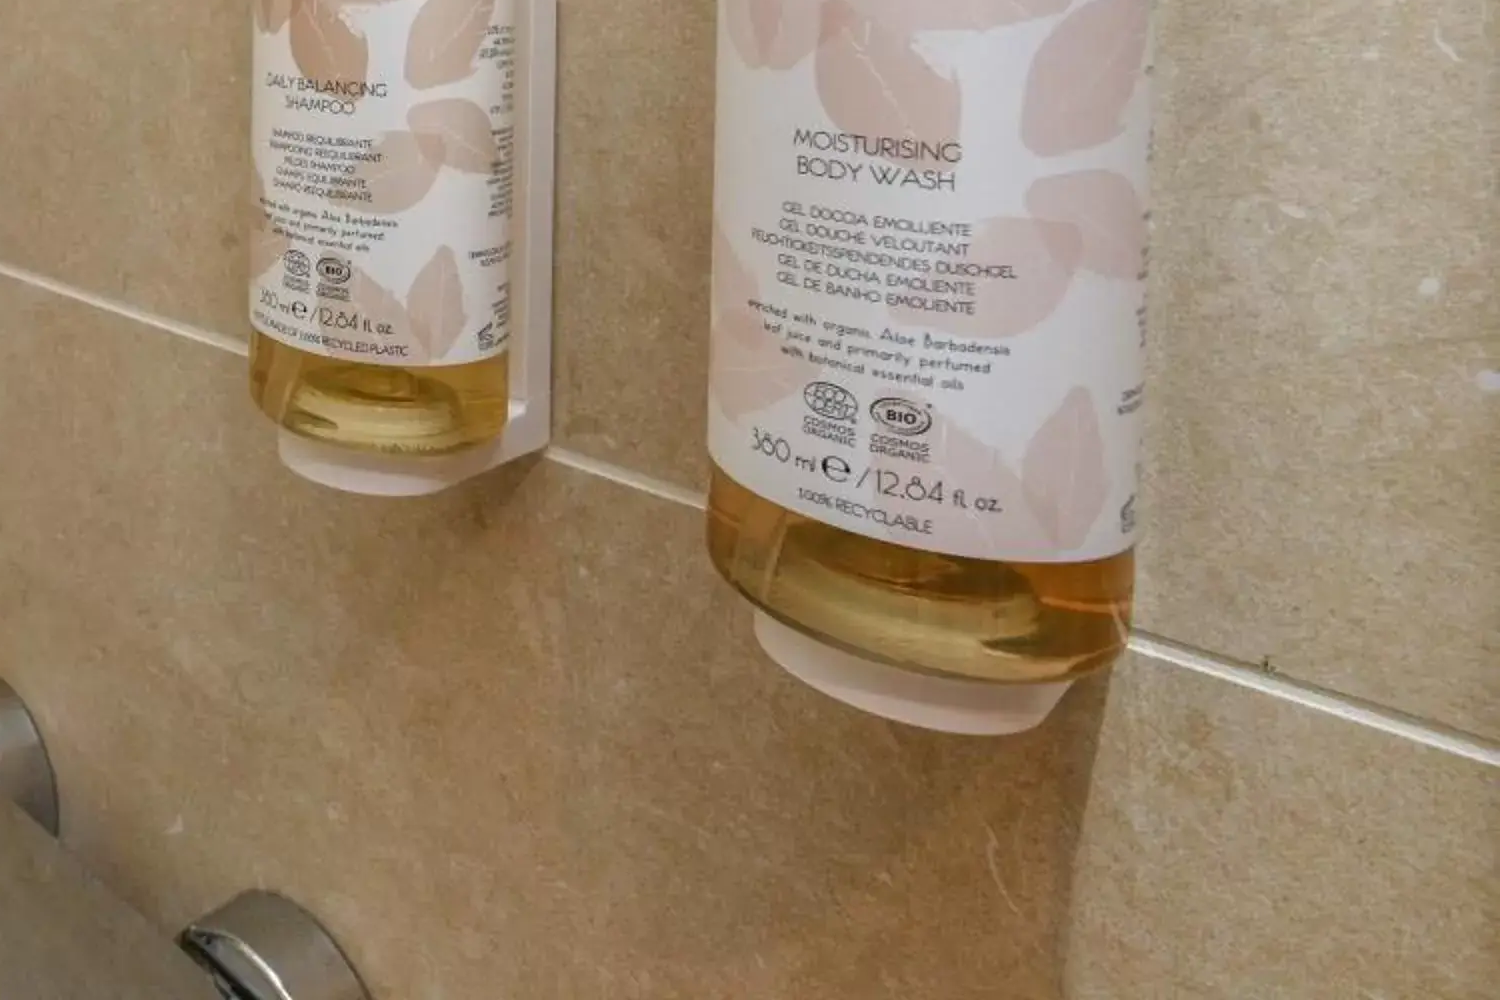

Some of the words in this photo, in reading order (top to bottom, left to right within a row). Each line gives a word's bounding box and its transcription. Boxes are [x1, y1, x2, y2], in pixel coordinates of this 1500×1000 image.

[297, 77, 388, 98] BALANCING
[285, 95, 356, 115] SHAMPOO
[793, 127, 962, 163] MOISTURISING
[796, 155, 863, 182] BODY
[870, 163, 955, 192] WASH
[870, 234, 970, 256] VELOUTANT
[880, 328, 915, 346] Aloe
[818, 338, 841, 351] and
[919, 358, 991, 374] perfumed
[872, 369, 933, 387] essential
[886, 408, 917, 425] BIO
[835, 497, 933, 535] RECYCLABLE
